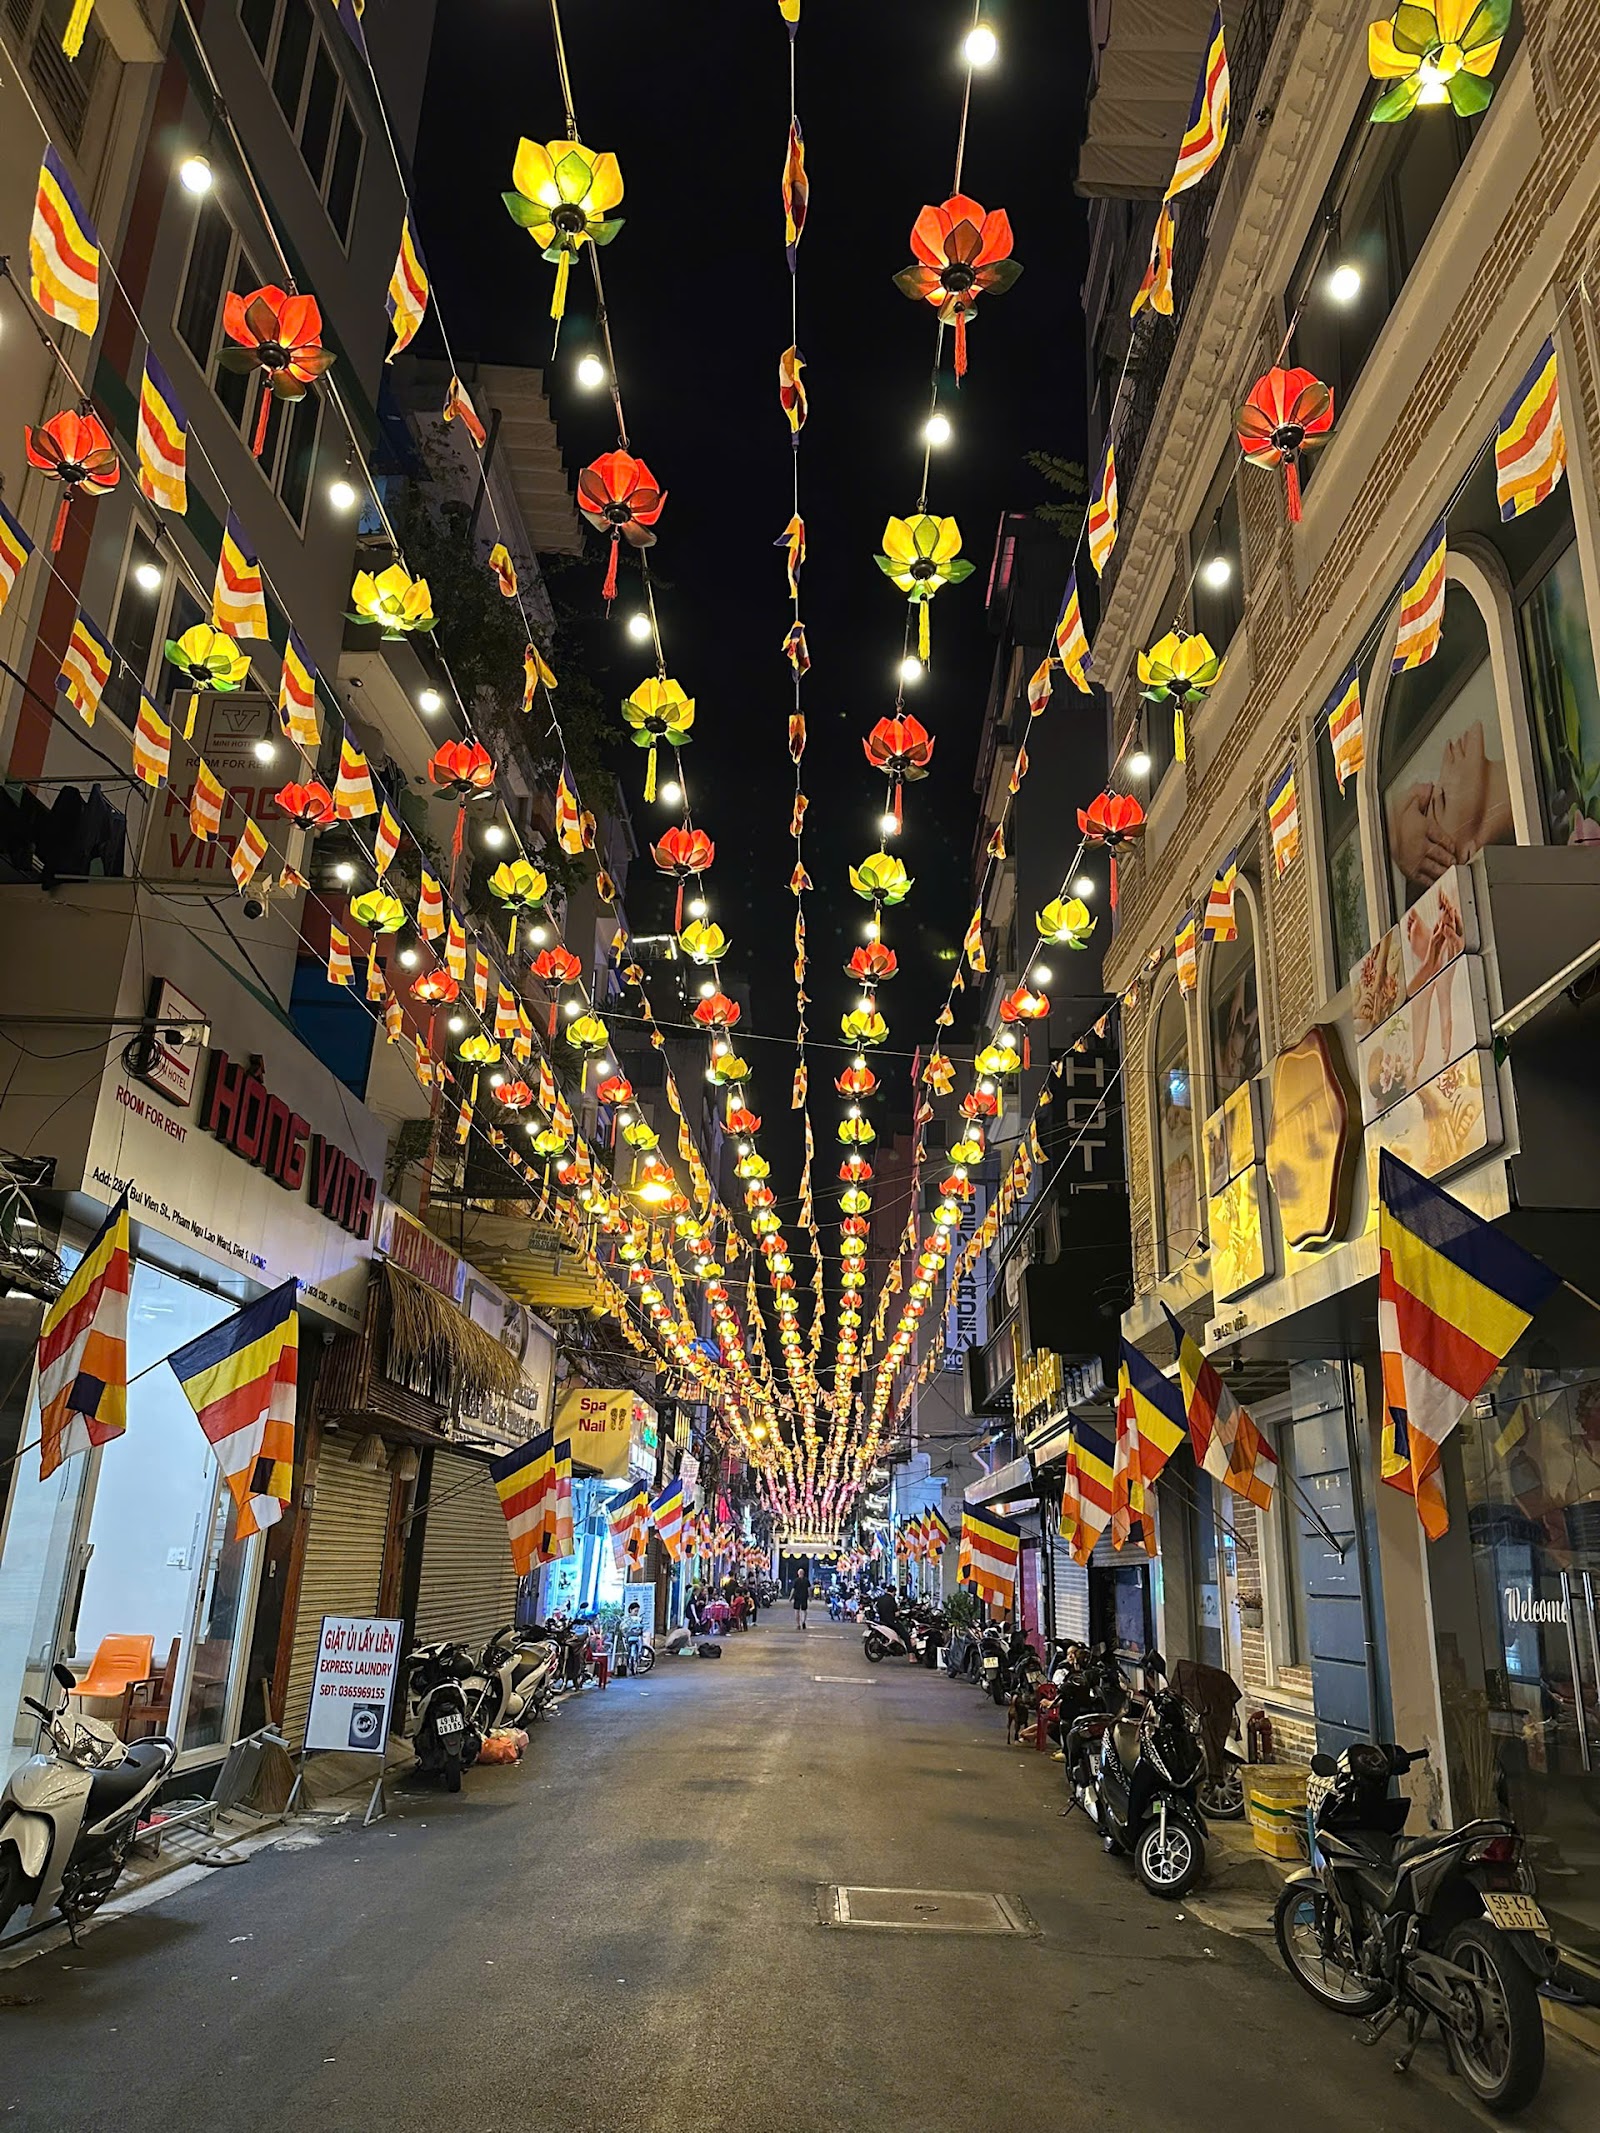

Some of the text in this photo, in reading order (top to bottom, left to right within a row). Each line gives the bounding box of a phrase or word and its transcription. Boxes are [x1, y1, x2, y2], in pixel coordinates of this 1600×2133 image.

[212, 740, 230, 748] MINI
[186, 757, 219, 768] ROOM
[222, 759, 245, 769] FOR
[168, 1068, 187, 1091] HOTEL
[116, 1085, 187, 1143] ROOM FOR RENT
[92, 1166, 112, 1187] Add:
[130, 1188, 144, 1202] Bui
[144, 1194, 159, 1213] Vien
[172, 1210, 191, 1230] Pham
[191, 1220, 204, 1239] Ngu
[204, 1227, 215, 1243] Lao
[216, 1234, 232, 1256] Ward,
[580, 1397, 607, 1414] Spa
[578, 1418, 606, 1432] Nail
[1504, 1583, 1568, 1623] Welcome
[324, 1624, 395, 1654] GIẶT ỦI LẤY LIỀN
[320, 1659, 392, 1677] EXPRESS LAUNDRY
[319, 1684, 385, 1699] SĐT: 0365969155
